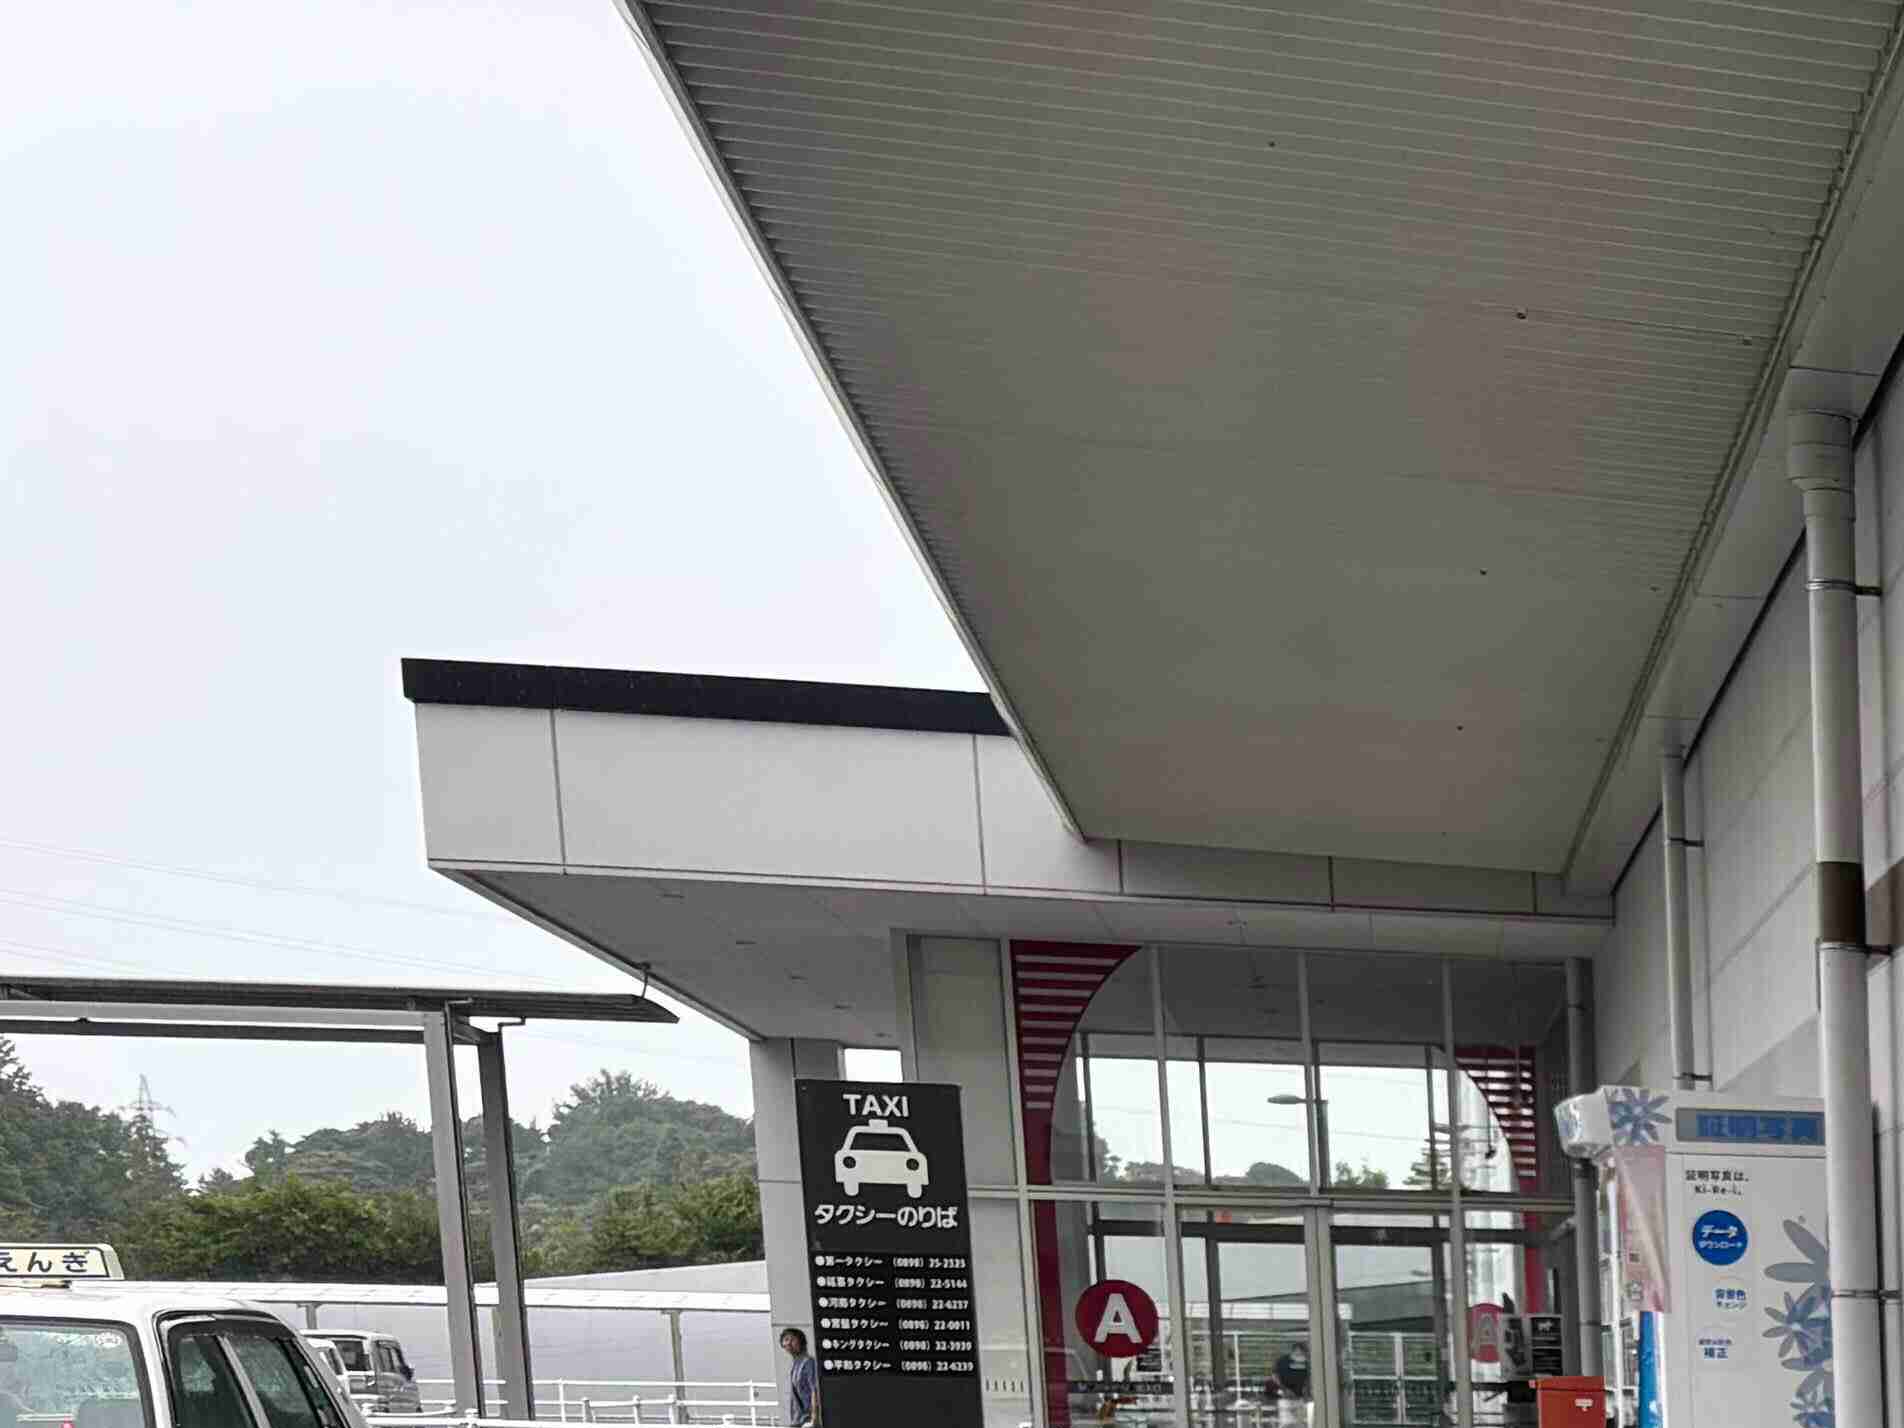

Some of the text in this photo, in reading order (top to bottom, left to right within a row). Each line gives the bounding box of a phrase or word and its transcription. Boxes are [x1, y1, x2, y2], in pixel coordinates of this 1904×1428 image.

[842, 1093, 910, 1118] TAXI
[814, 1203, 958, 1229] タクシーのりば
[0, 1250, 90, 1273] えんぎ
[1093, 1292, 1143, 1344] A
